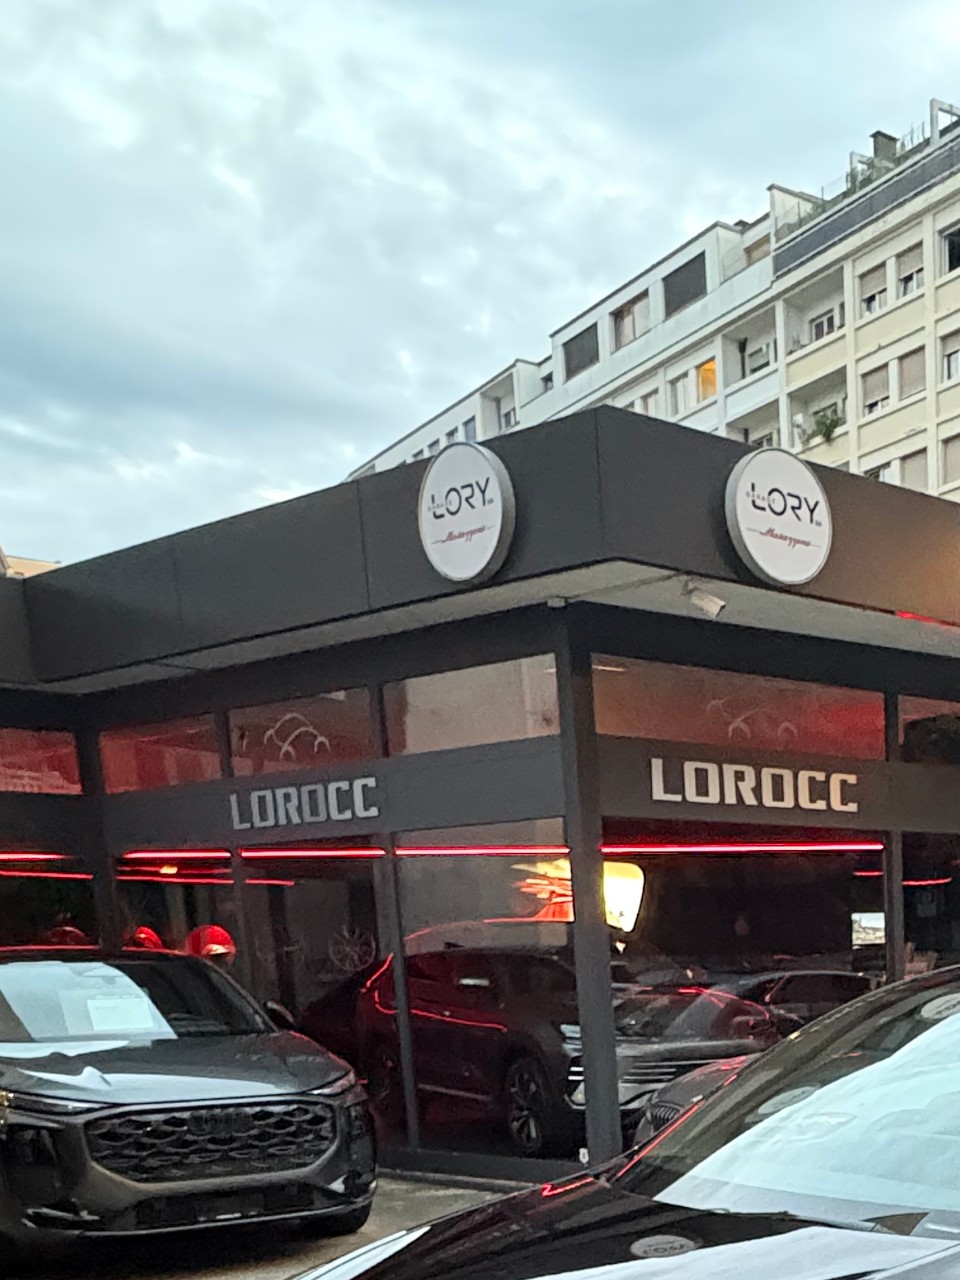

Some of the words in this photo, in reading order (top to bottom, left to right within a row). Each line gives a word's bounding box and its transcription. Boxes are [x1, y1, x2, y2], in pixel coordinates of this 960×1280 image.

[431, 477, 490, 520] LORY
[751, 482, 820, 525] LORY
[229, 777, 379, 830] LOROCC
[650, 757, 859, 812] LOROCC
